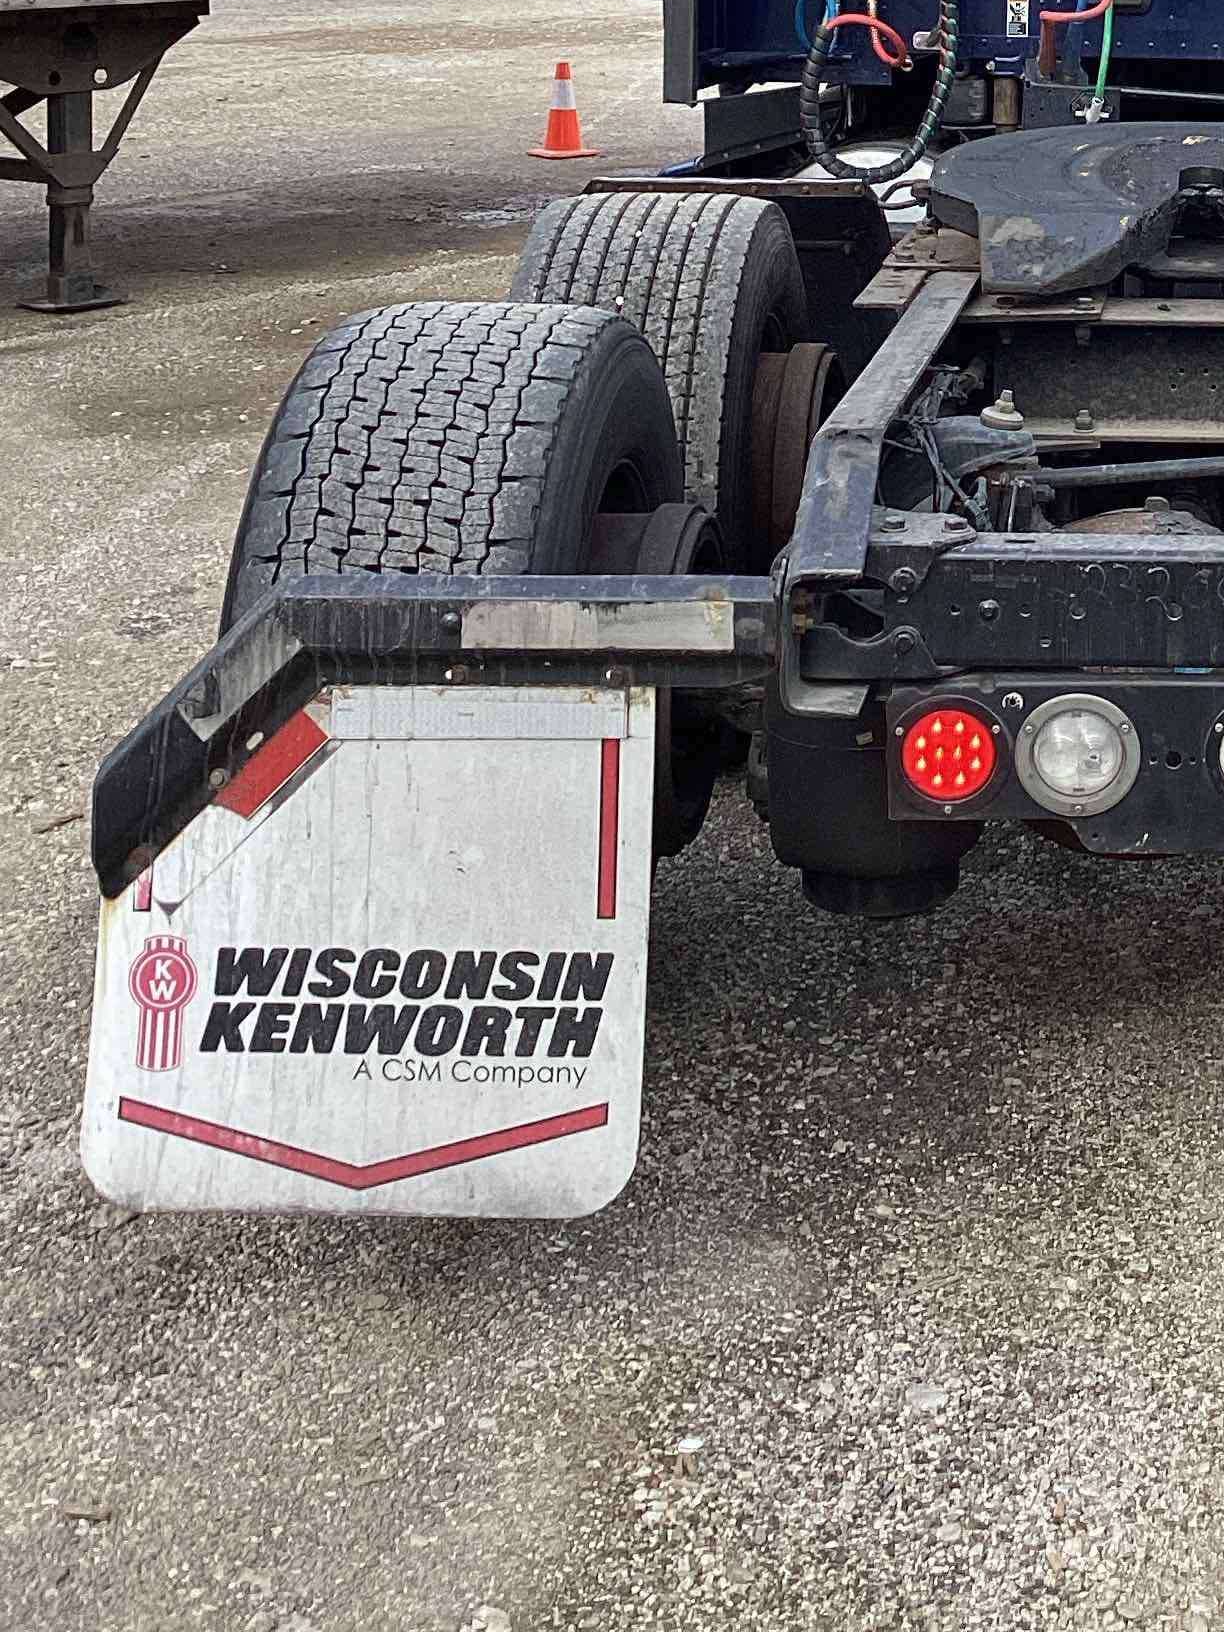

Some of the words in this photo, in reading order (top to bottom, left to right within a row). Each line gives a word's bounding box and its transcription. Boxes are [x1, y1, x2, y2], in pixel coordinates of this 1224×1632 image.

[154, 959, 173, 980] K
[213, 947, 615, 1002] WISCONSIN
[149, 979, 177, 1001] W
[199, 1002, 604, 1058] KENWORTH
[352, 1060, 373, 1081] A
[382, 1060, 443, 1083] CSM
[450, 1060, 588, 1088] Company
